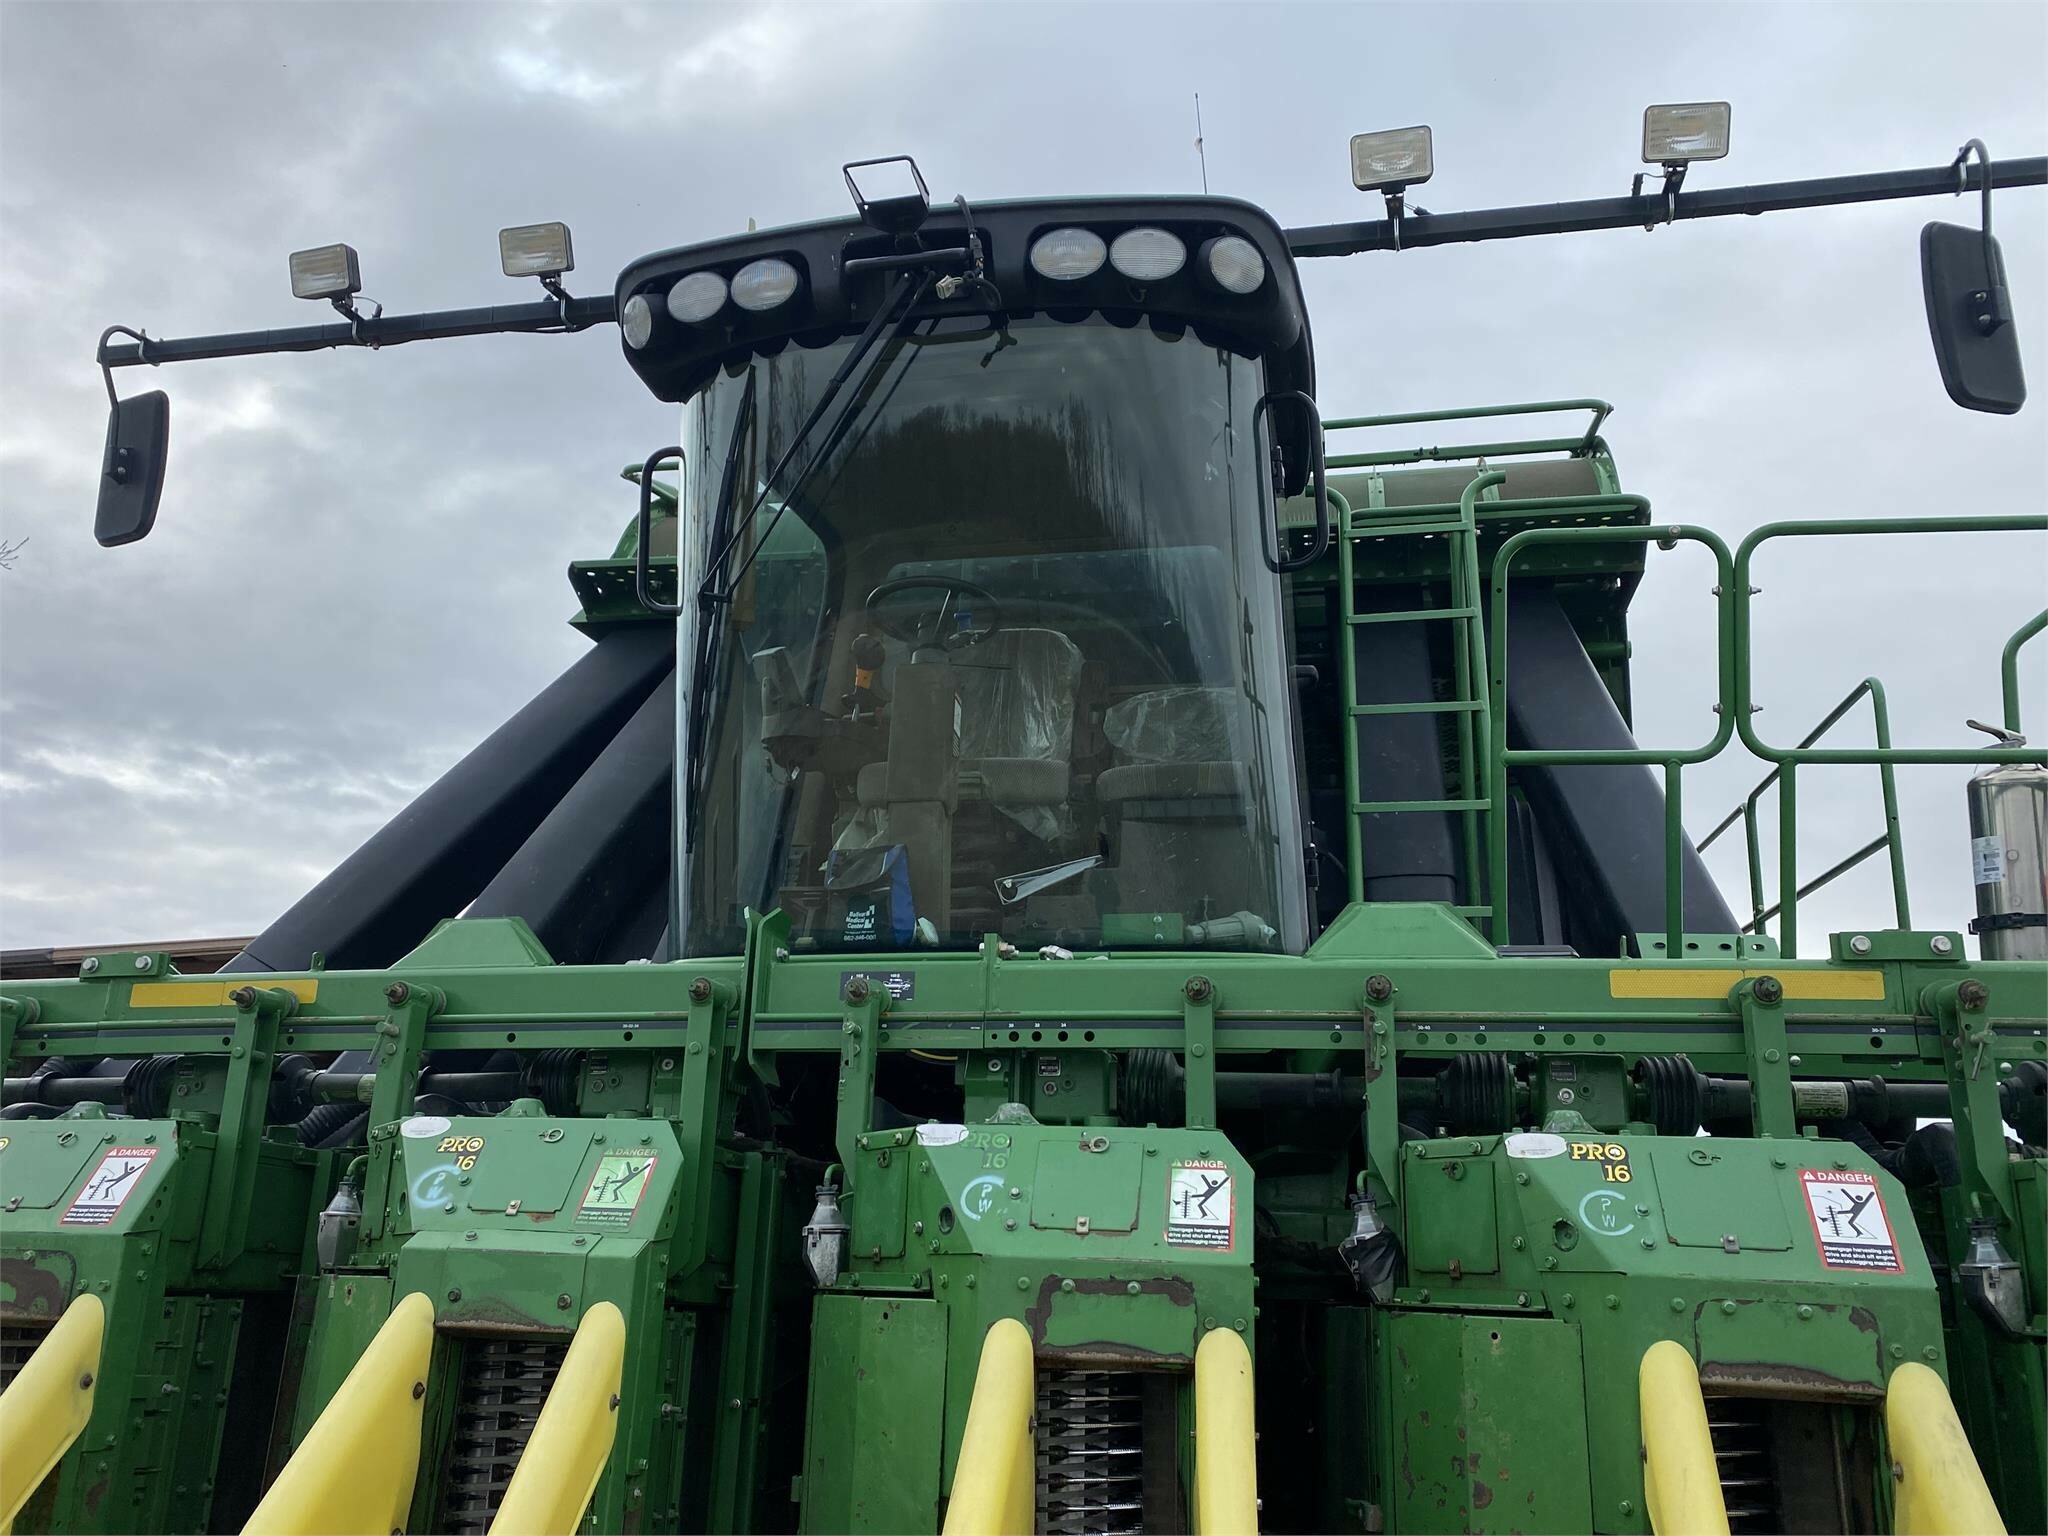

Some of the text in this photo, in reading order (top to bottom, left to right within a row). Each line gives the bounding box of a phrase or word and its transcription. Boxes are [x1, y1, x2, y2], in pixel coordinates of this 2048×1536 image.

[437, 1136, 484, 1153] PRO
[961, 1131, 1010, 1149] PRO
[118, 1148, 157, 1156] DANGER
[615, 1148, 658, 1156] DANGER
[1570, 1142, 1626, 1161] PRO
[456, 1155, 477, 1171] 16
[982, 1152, 1008, 1169] 16
[1184, 1159, 1228, 1169] DANGE
[1604, 1163, 1631, 1182] 16
